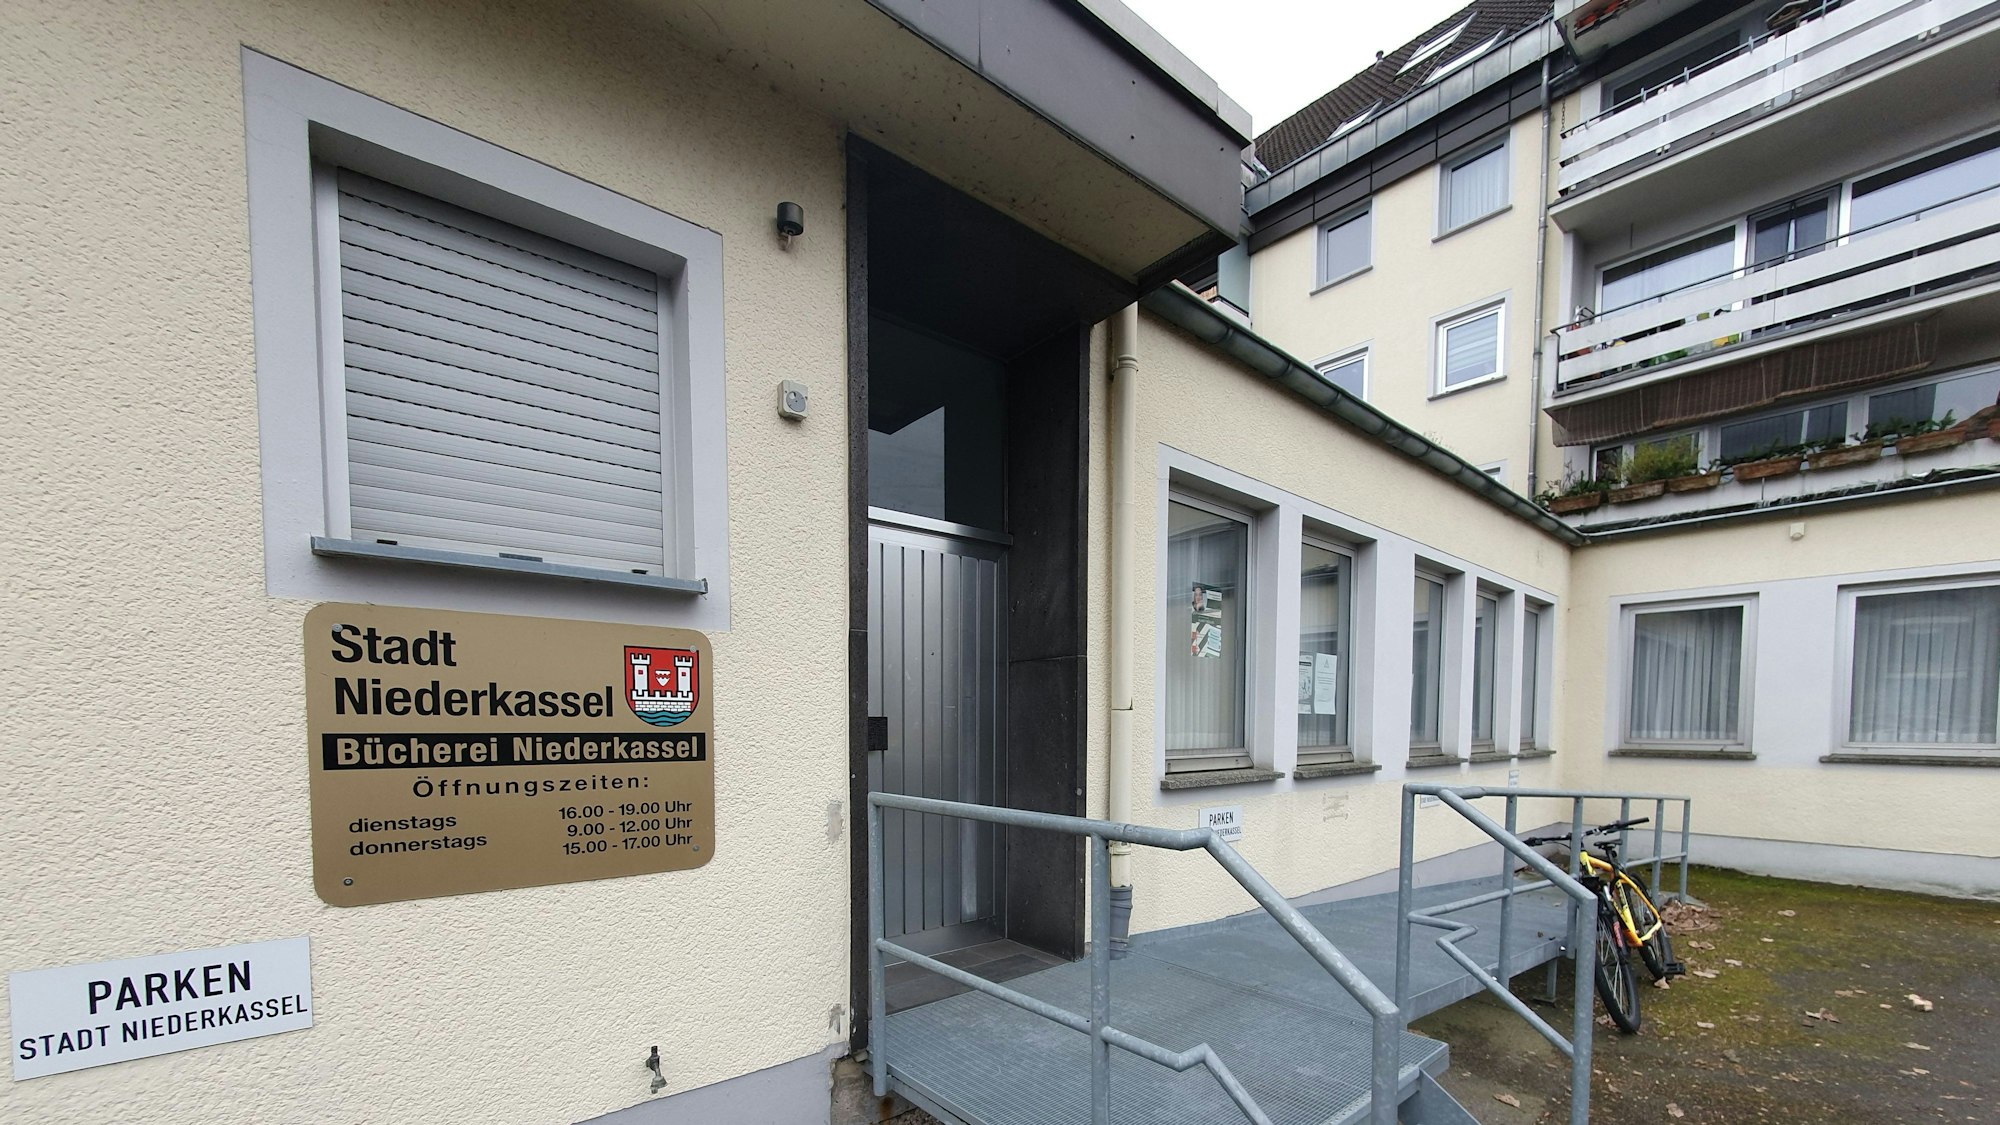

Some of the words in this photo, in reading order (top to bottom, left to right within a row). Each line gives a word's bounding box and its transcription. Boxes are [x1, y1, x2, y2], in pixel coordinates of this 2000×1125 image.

[331, 623, 457, 667] Stadt
[335, 677, 614, 718] Niederkassel
[337, 736, 499, 766] Bücherei
[513, 735, 699, 761] Niederkassel
[412, 775, 650, 798] Öffnungszeiten:
[349, 815, 457, 834] dienstags
[558, 805, 604, 820] 16.00
[618, 801, 660, 816] 19.00
[664, 800, 693, 813] Uhr
[1209, 811, 1234, 826] PARKEN
[349, 834, 488, 856] donnerstags
[567, 822, 605, 837] 9.00
[619, 818, 660, 833] 12.00
[665, 817, 693, 830] Uhr
[562, 840, 607, 855] 15.00
[621, 835, 661, 850] 17.00
[665, 833, 693, 846] Uhr
[88, 960, 251, 1015] PARKEN
[19, 1025, 111, 1060] STADT
[122, 994, 308, 1042] NIEDERKASSEL
